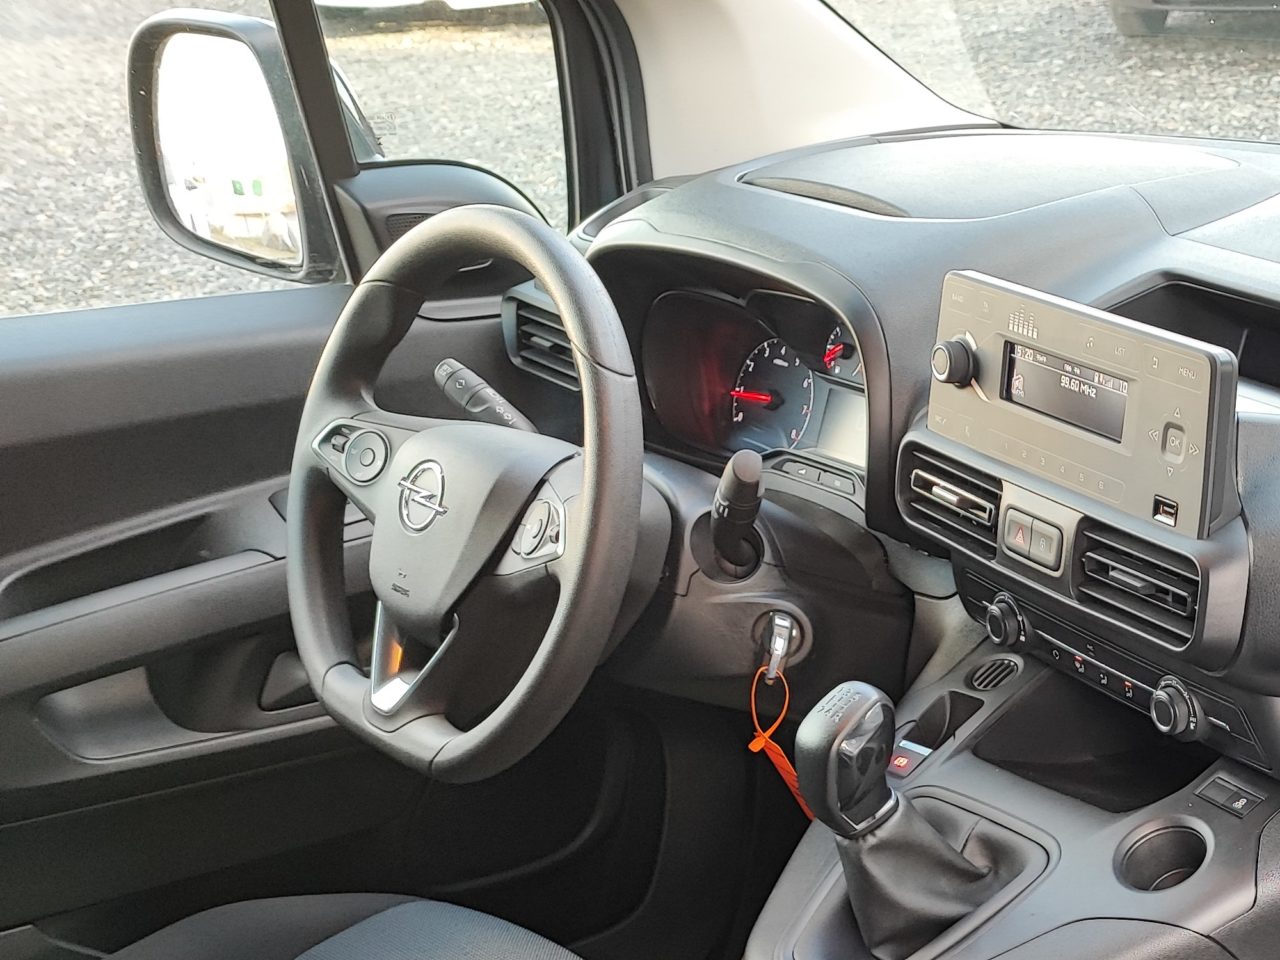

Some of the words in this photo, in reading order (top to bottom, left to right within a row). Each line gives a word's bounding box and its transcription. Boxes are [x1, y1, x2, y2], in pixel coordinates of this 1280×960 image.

[1014, 344, 1035, 361] 15:20
[1178, 366, 1197, 380] MENU
[1060, 375, 1080, 393] 99.60
[1080, 381, 1097, 398] MHz
[1169, 436, 1181, 448] OK
